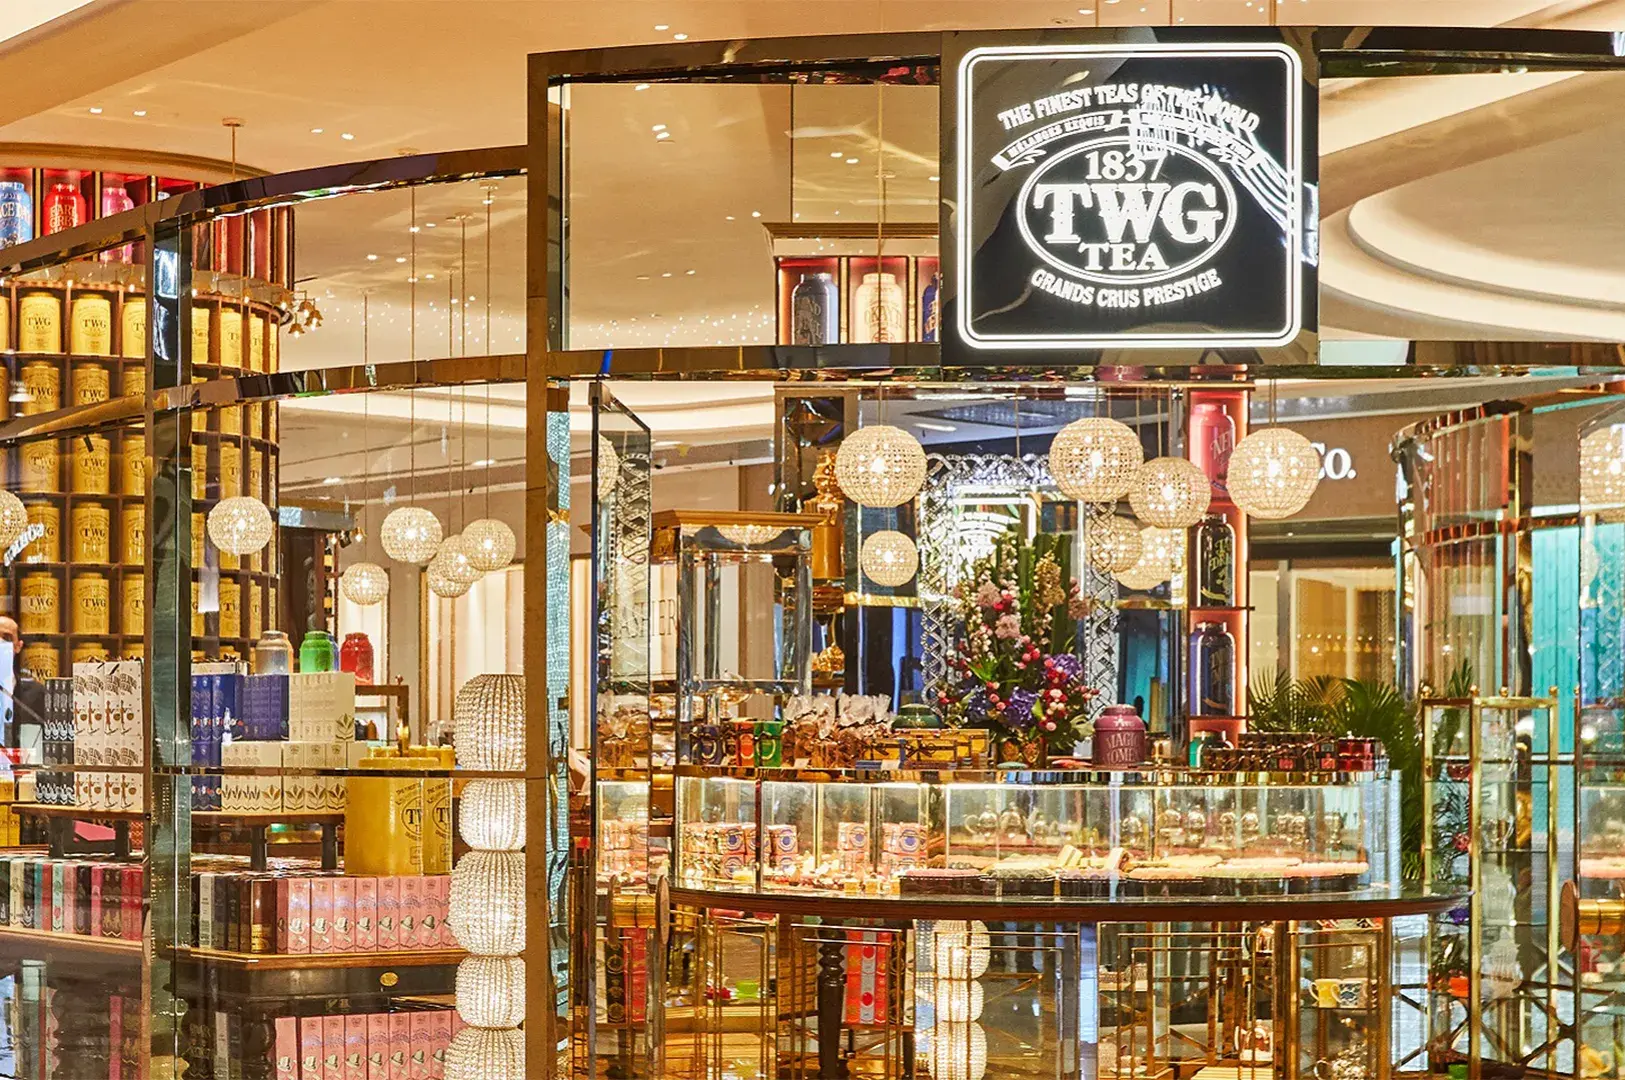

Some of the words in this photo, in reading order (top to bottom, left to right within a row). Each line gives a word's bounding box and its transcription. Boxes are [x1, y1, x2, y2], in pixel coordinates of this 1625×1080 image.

[997, 103, 1035, 129] THE
[1033, 87, 1092, 119] FINEST
[1094, 83, 1138, 105] TEAS
[1085, 150, 1167, 181] 1837
[1033, 181, 1224, 244] TWG
[1078, 242, 1170, 270] TEA
[1031, 268, 1095, 305] GRANDS
[1096, 288, 1140, 308] CRUS
[1143, 267, 1223, 307] PRESTIGE
[27, 317, 51, 326] TWG
[83, 319, 107, 328] TWG
[30, 387, 54, 396] TWG
[81, 389, 105, 399] TWG
[83, 458, 106, 468] TWG
[83, 528, 106, 537] TWG
[29, 597, 53, 607] TWG
[82, 598, 106, 608] TWG
